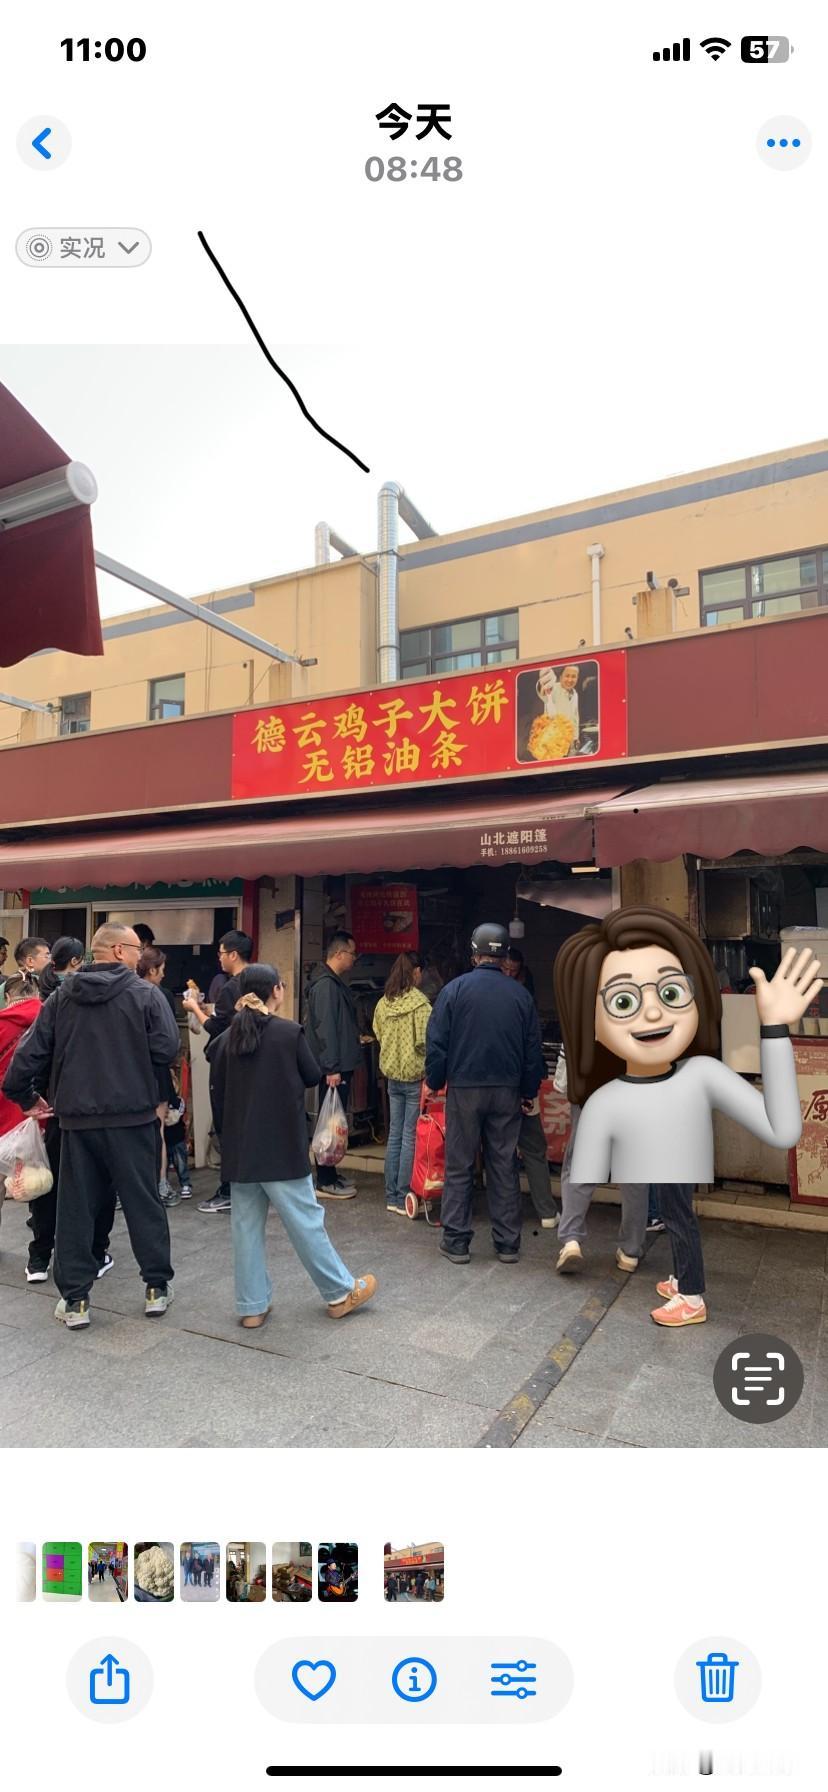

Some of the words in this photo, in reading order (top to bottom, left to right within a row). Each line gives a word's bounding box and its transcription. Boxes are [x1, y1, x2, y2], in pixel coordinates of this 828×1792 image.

[61, 38, 146, 62] 11:00
[749, 40, 780, 59] 57
[376, 103, 452, 140] 今天
[365, 157, 462, 181] 08:48
[60, 236, 105, 259] 实况
[251, 679, 510, 753] 德云鸡子大饼
[297, 731, 468, 784] 无铝油条
